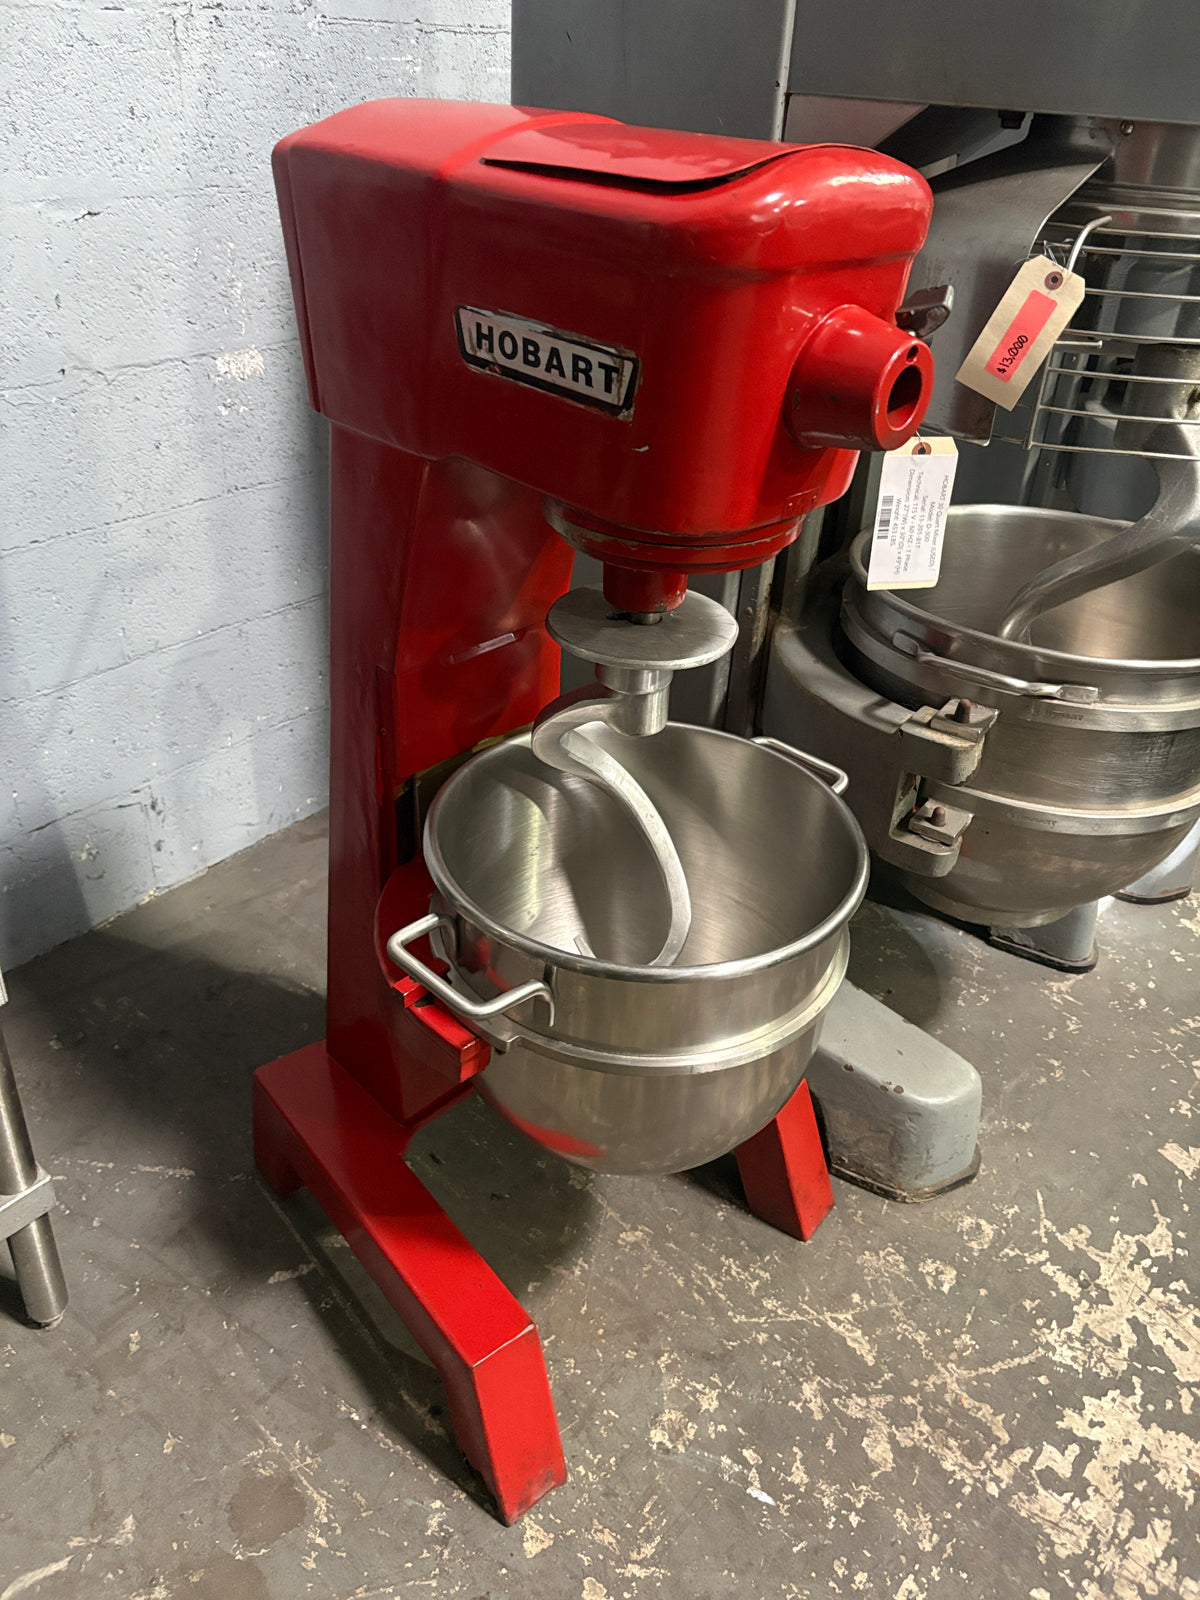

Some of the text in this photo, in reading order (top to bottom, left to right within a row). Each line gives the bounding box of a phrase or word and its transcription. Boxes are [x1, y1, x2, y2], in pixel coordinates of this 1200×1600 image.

[476, 322, 620, 394] HOBART
[996, 335, 1028, 373] $13,000
[914, 472, 923, 500] Technical:
[940, 475, 949, 500] HOBART
[894, 498, 902, 520] Weight:
[903, 554, 911, 571] Phase
